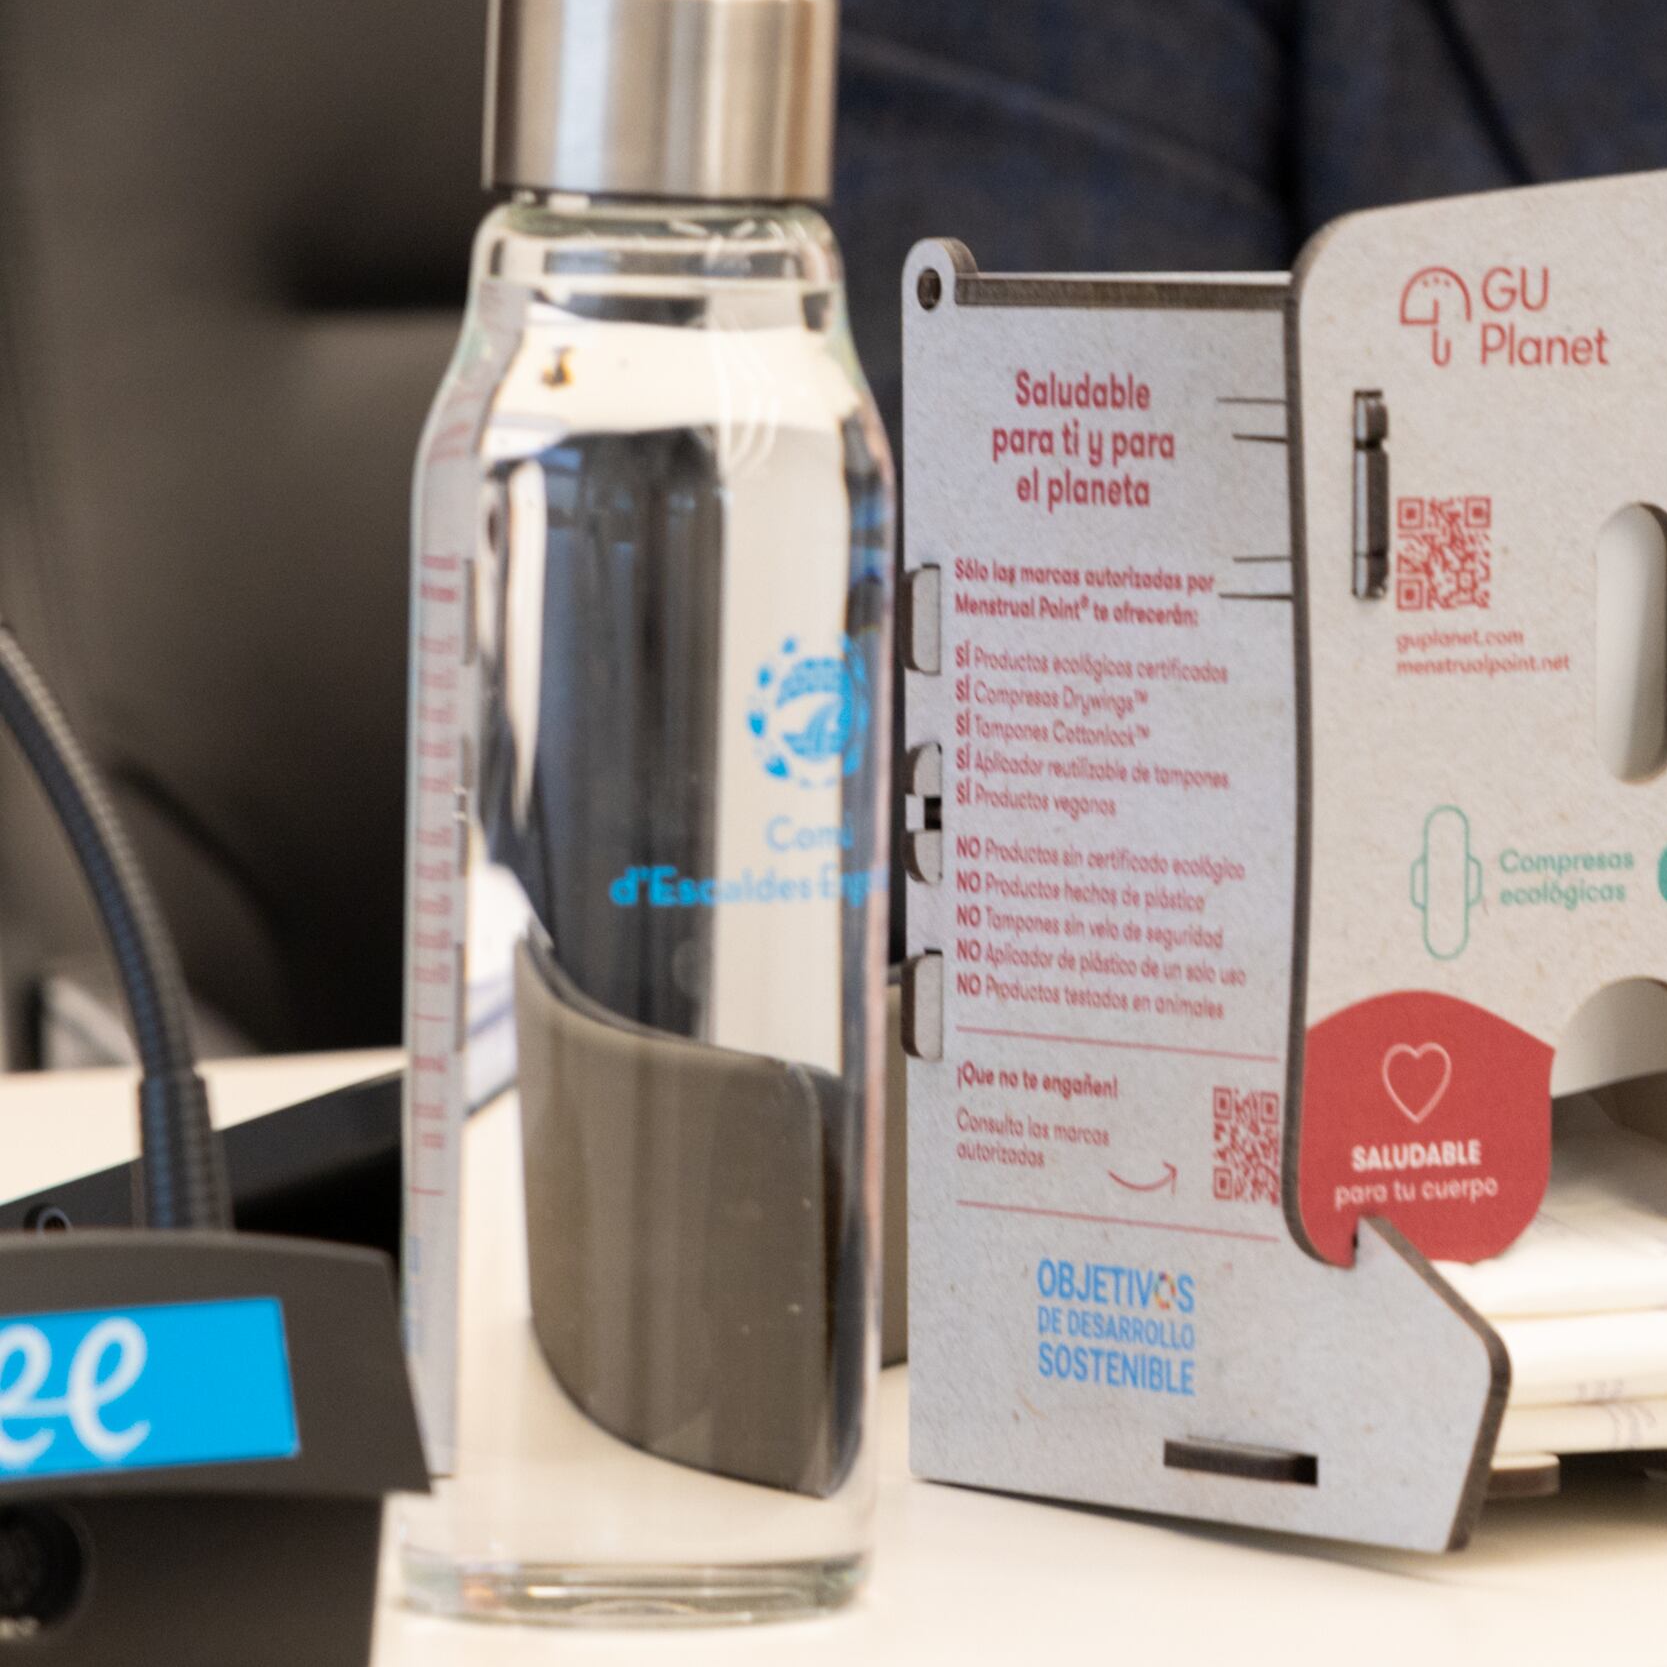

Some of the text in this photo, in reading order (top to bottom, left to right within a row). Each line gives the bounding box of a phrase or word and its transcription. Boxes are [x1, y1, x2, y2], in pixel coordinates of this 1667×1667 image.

[1481, 266, 1549, 312] GU
[1480, 322, 1609, 366] Planet
[1015, 369, 1150, 410] Saludable
[992, 419, 1176, 468] para ti y para
[1016, 467, 1151, 513] el planeta
[954, 556, 1216, 596] Sólo las marcas autorizadas por
[955, 593, 1036, 620] Menstrual
[1093, 601, 1109, 622] te
[1113, 602, 1198, 627] ofrecerán:
[1396, 629, 1524, 653] guplanet.com
[974, 644, 1049, 674] Productos
[1053, 651, 1133, 683] ecológicos
[1137, 656, 1228, 684] certificados
[1397, 653, 1570, 677] menstrualpoint.net
[974, 679, 1060, 710] Compresas
[975, 714, 1048, 744] Tampones
[975, 750, 1044, 778] Aplicador
[1050, 754, 1127, 782] reutilizable
[1132, 761, 1150, 784] de
[1154, 766, 1230, 789] tampones
[975, 784, 1049, 812] Productos
[1054, 795, 1116, 821] veganos
[956, 835, 1245, 885] NO Productos sin certificado ecológico
[1499, 848, 1634, 877] Compresas
[956, 870, 1205, 912] NO Productos hechos de plástico
[1500, 880, 1626, 912] ecológicas
[956, 904, 1224, 951] NO Tampones sin velo de seguridad
[956, 938, 1246, 987] NO Aplicador de plástico de un solo uso
[956, 972, 1225, 1019] NO Productos testados en animales
[956, 1060, 1118, 1100] ¡Que no te engañen!
[957, 1106, 1110, 1148] Consulta las marcas
[957, 1141, 1045, 1168] autorizadas
[1351, 1139, 1482, 1172] SALUDABLE
[1334, 1176, 1498, 1212] para tu cuerpo
[1036, 1257, 1196, 1314] OBJETIVOS
[1037, 1305, 1195, 1352] DE DESARROLLO
[1038, 1341, 1195, 1396] SOSTENIBLE
